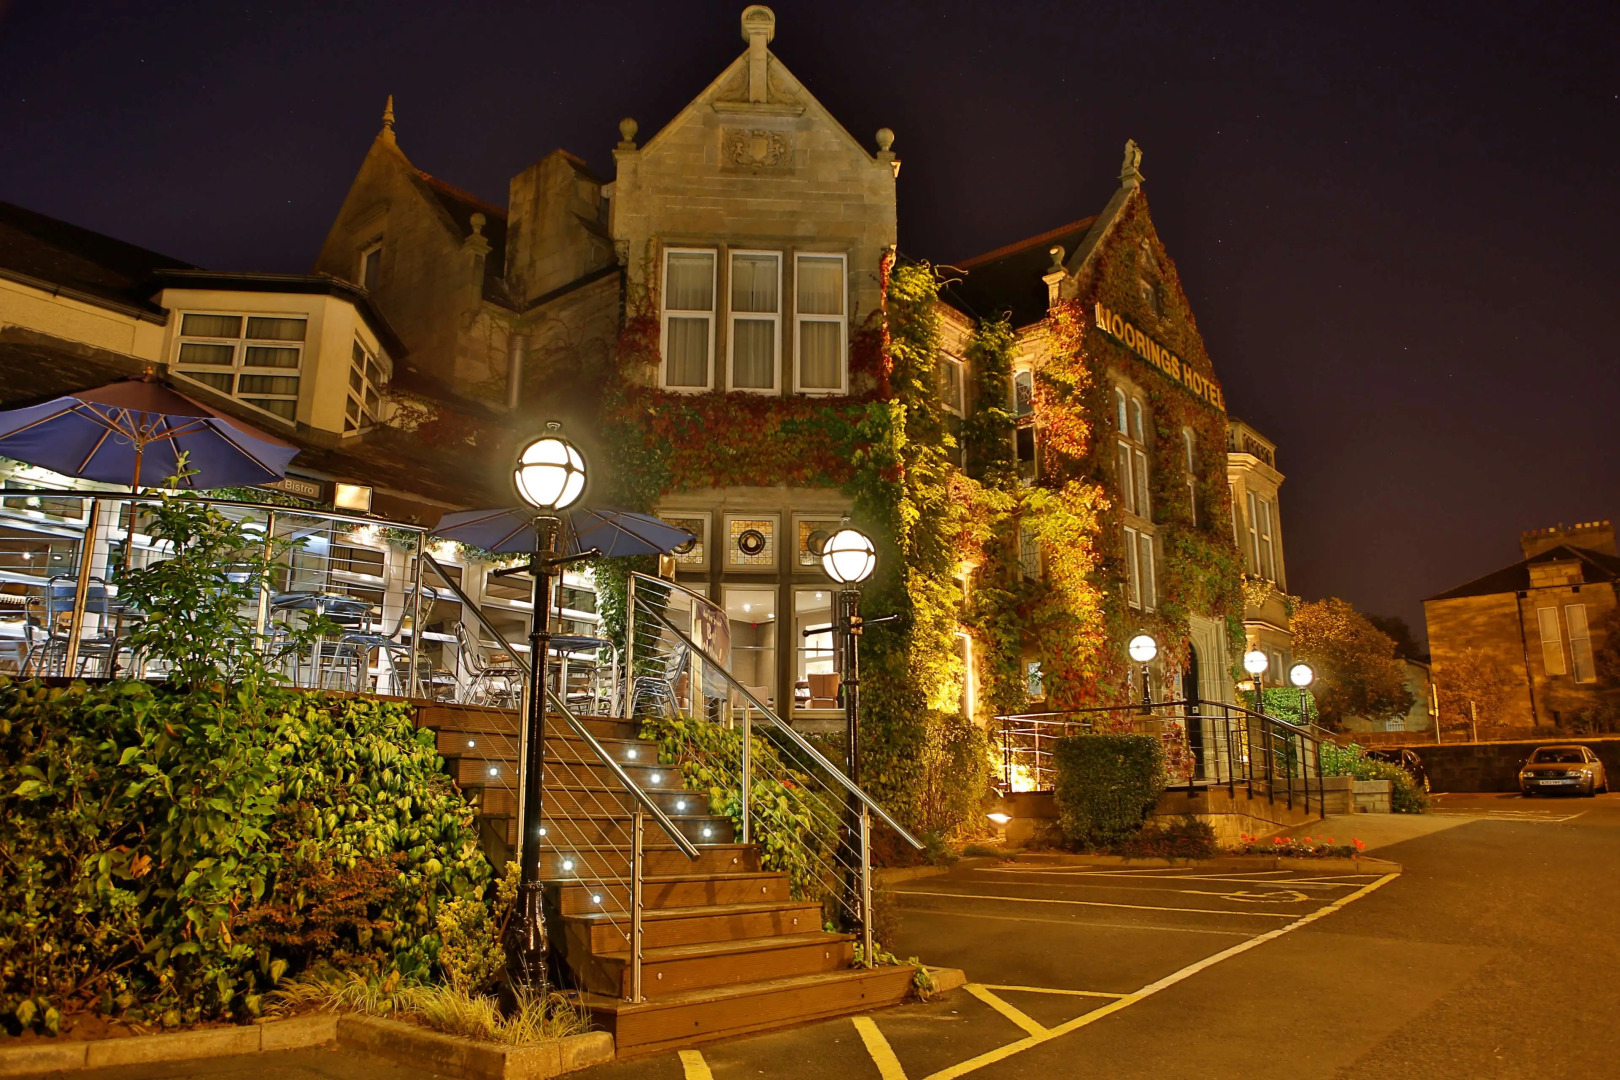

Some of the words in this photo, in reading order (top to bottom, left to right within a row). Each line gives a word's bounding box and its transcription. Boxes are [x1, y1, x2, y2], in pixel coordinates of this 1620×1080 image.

[1095, 301, 1180, 380] MOORINGS
[1183, 363, 1225, 412] HOTEL
[284, 479, 314, 495] Bistro
